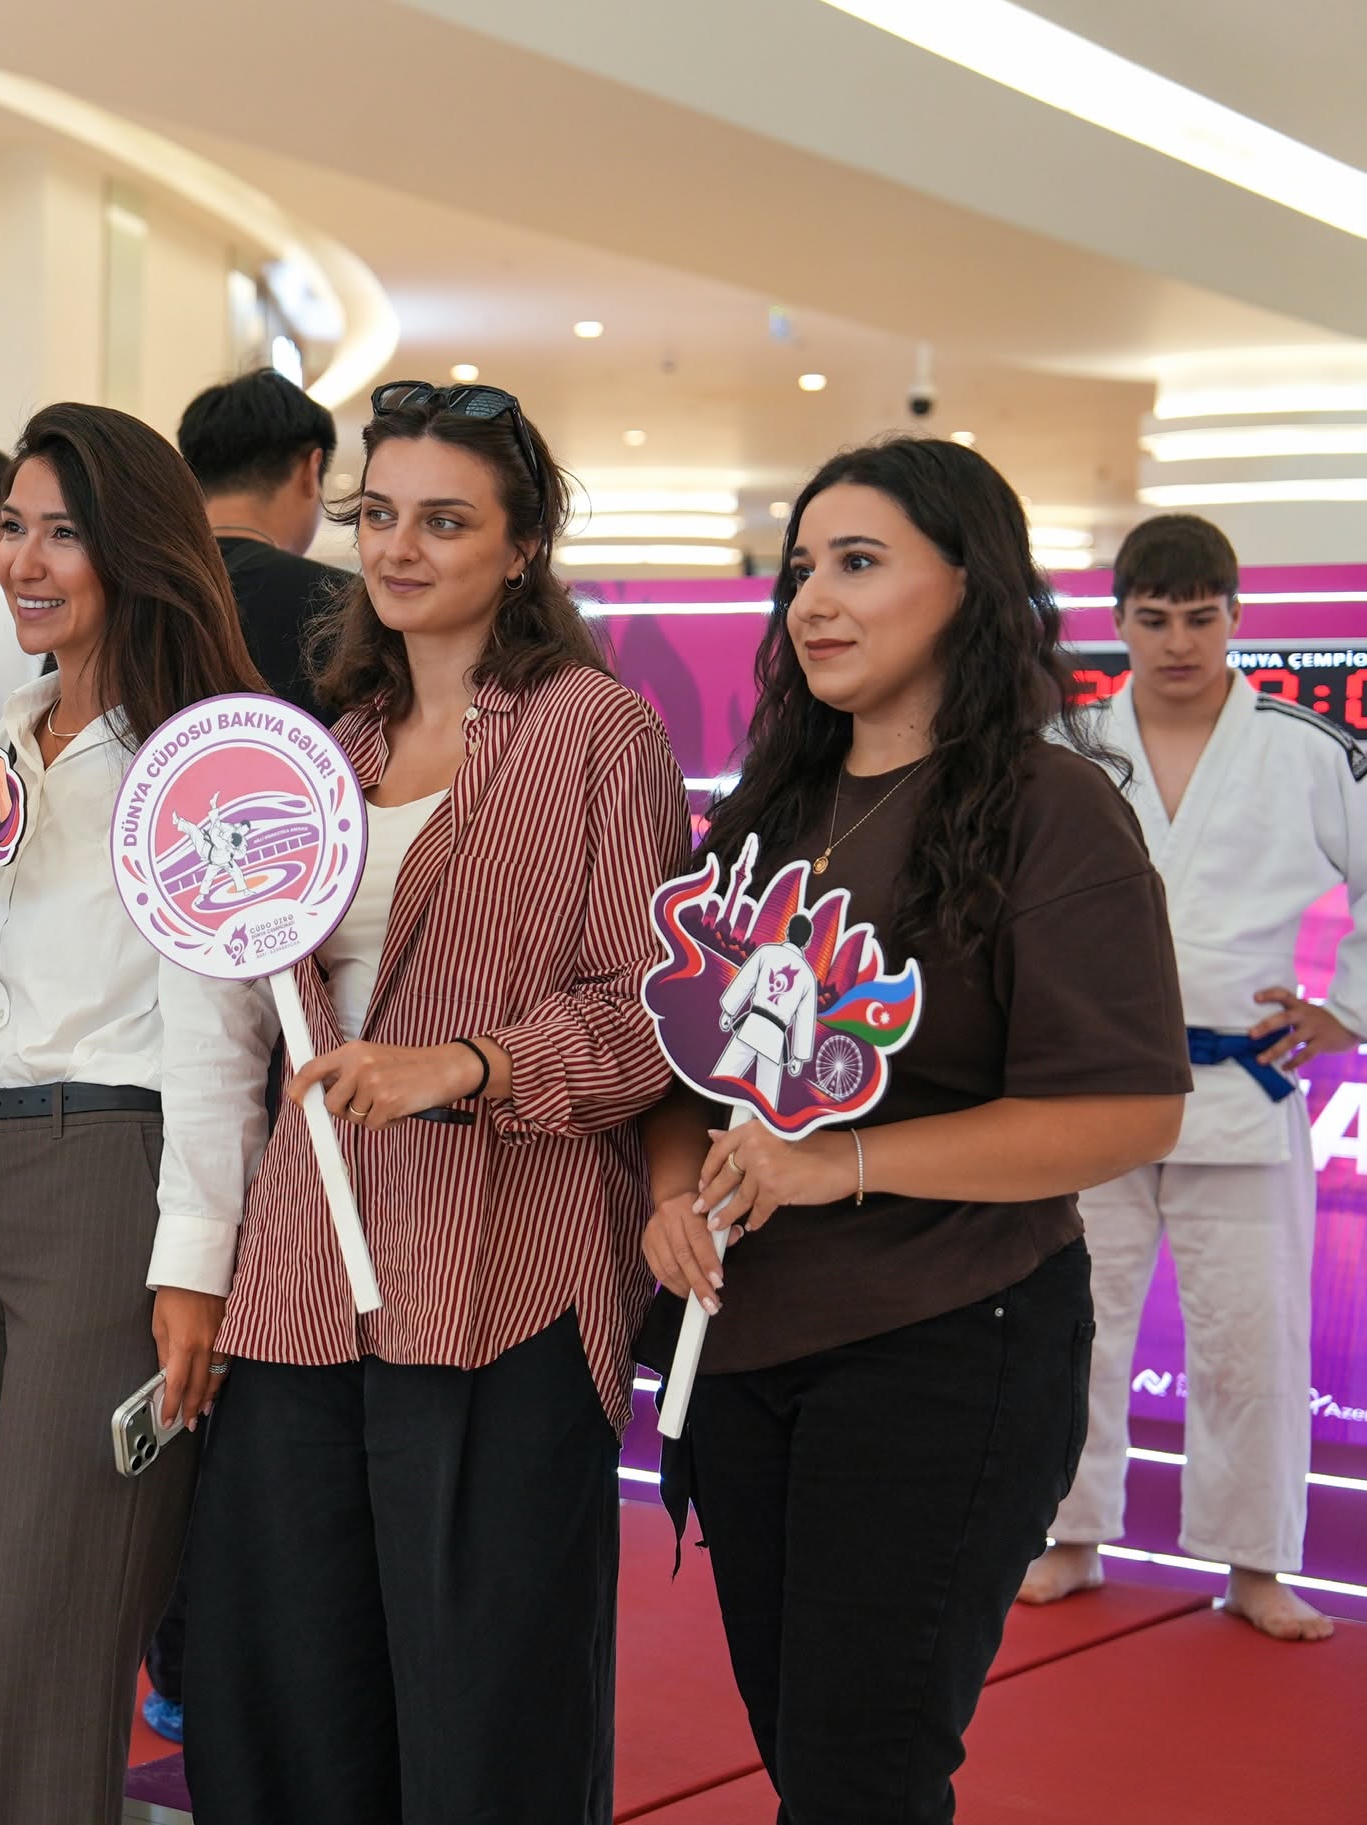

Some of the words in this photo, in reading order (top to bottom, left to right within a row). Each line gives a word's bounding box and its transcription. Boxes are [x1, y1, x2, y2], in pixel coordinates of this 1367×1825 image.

[1226, 650, 1284, 668] ÜNYA
[121, 782, 152, 847] DÜNYA
[147, 718, 212, 777] CÜDOSU
[218, 712, 284, 736] BAKIYA
[254, 927, 298, 953] 2026
[1324, 1402, 1367, 1422] Aze
